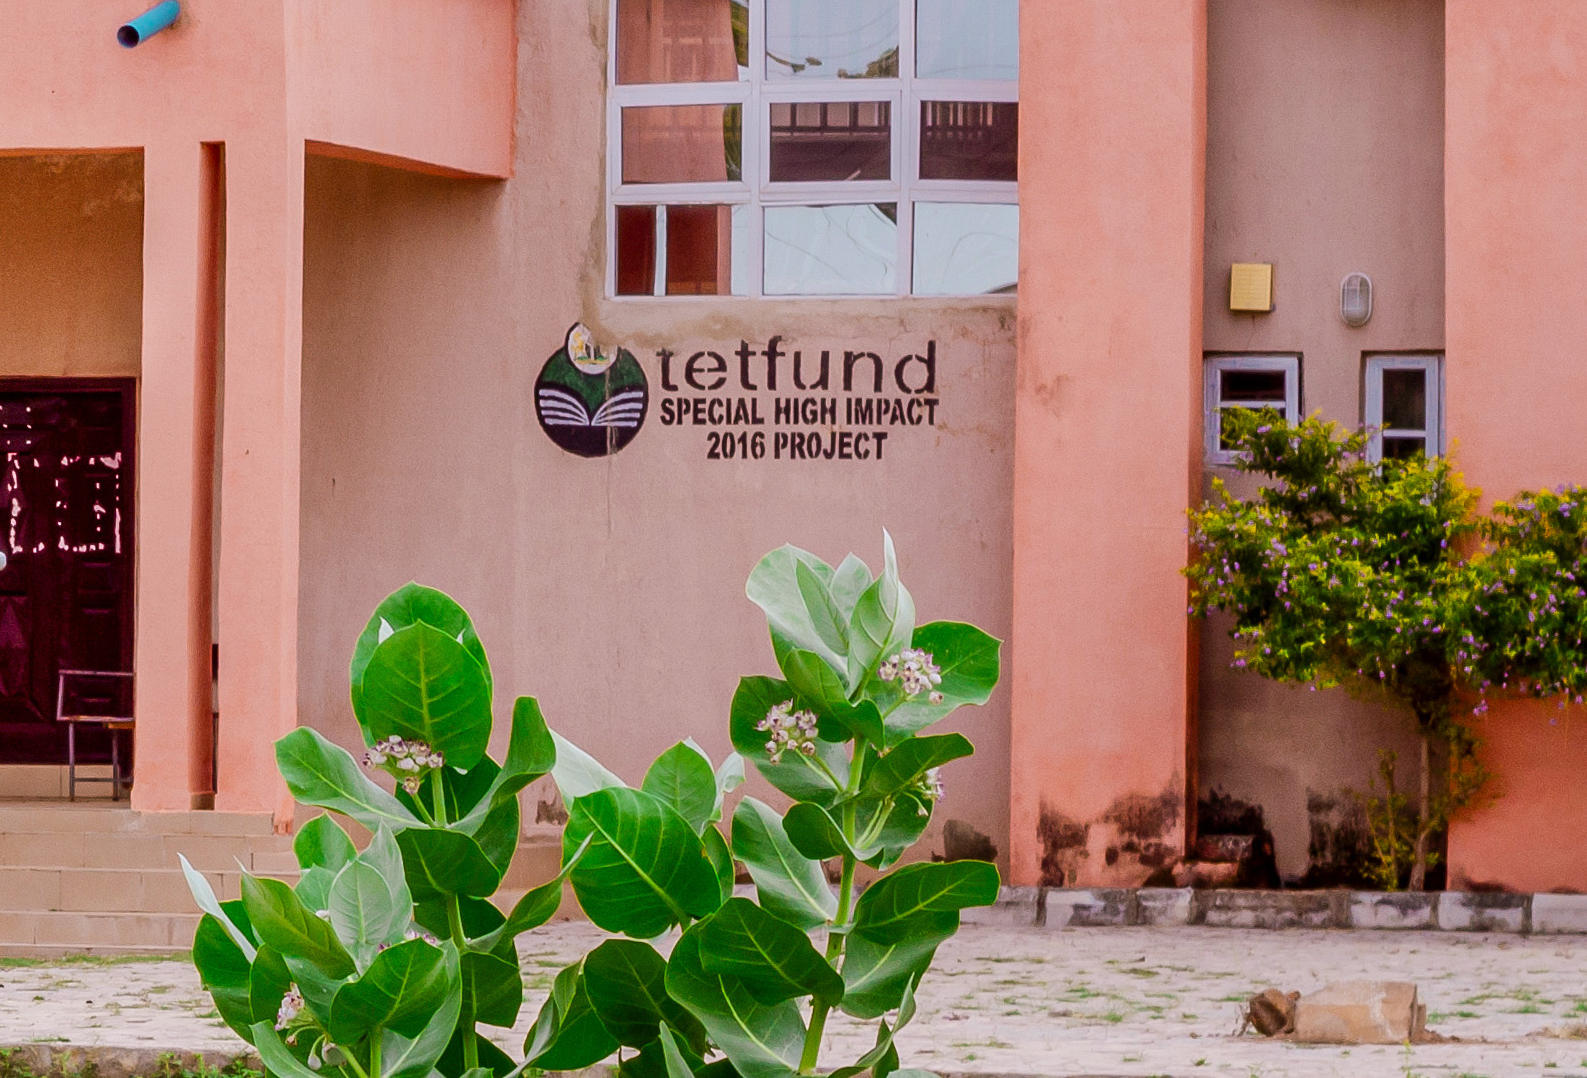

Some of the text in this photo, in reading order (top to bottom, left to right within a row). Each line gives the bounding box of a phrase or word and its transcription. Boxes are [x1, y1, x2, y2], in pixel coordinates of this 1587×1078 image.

[656, 335, 937, 394] tetfund
[660, 397, 940, 426] SPECIAL HIGH IMPACT
[707, 431, 888, 460] 2016 PROJECT
